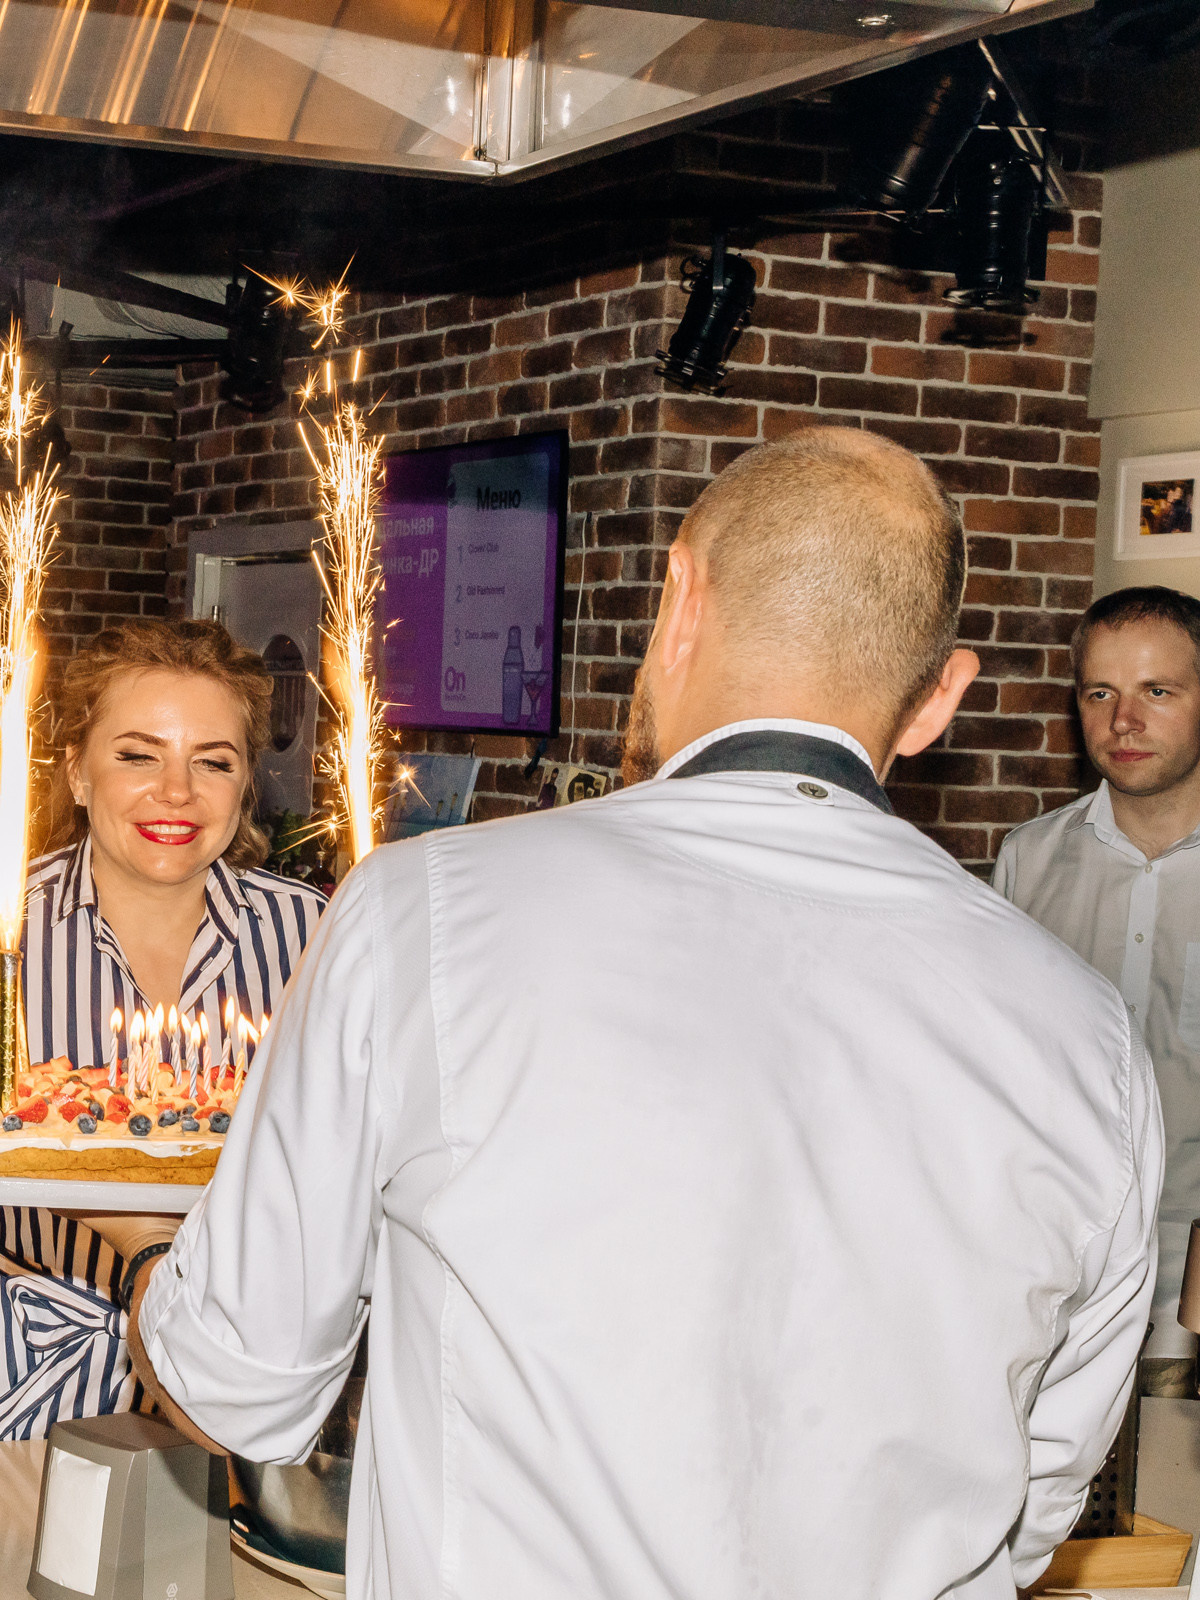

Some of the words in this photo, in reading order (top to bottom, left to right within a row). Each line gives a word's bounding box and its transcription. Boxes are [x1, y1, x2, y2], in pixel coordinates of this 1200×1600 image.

[476, 486, 522, 512] Меню
[455, 585, 463, 603] 2
[453, 627, 461, 647] 3
[444, 666, 466, 692] On
